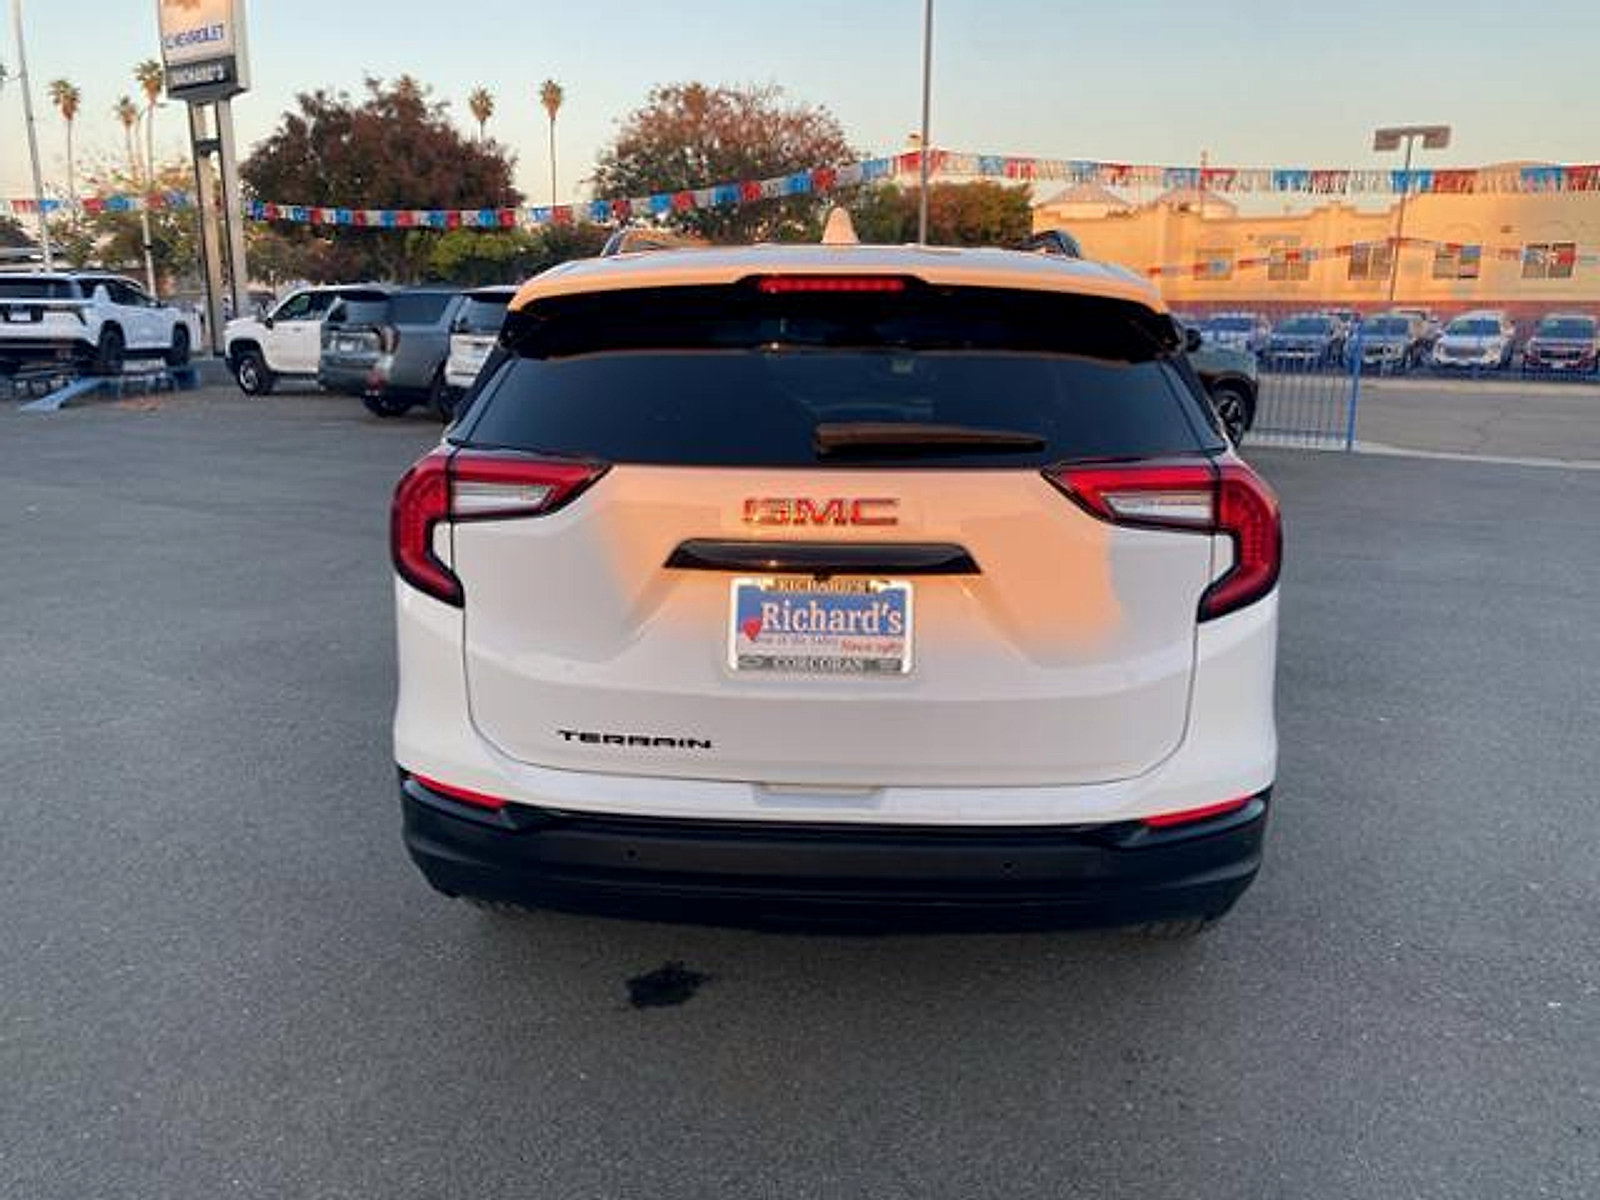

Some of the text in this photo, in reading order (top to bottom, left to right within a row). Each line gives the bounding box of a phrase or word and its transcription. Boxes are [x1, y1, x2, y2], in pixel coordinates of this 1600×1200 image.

[161, 24, 223, 49] CHEVROLET
[742, 498, 900, 526] GMC
[760, 600, 902, 634] Richard's
[557, 729, 711, 749] TERRAIN
